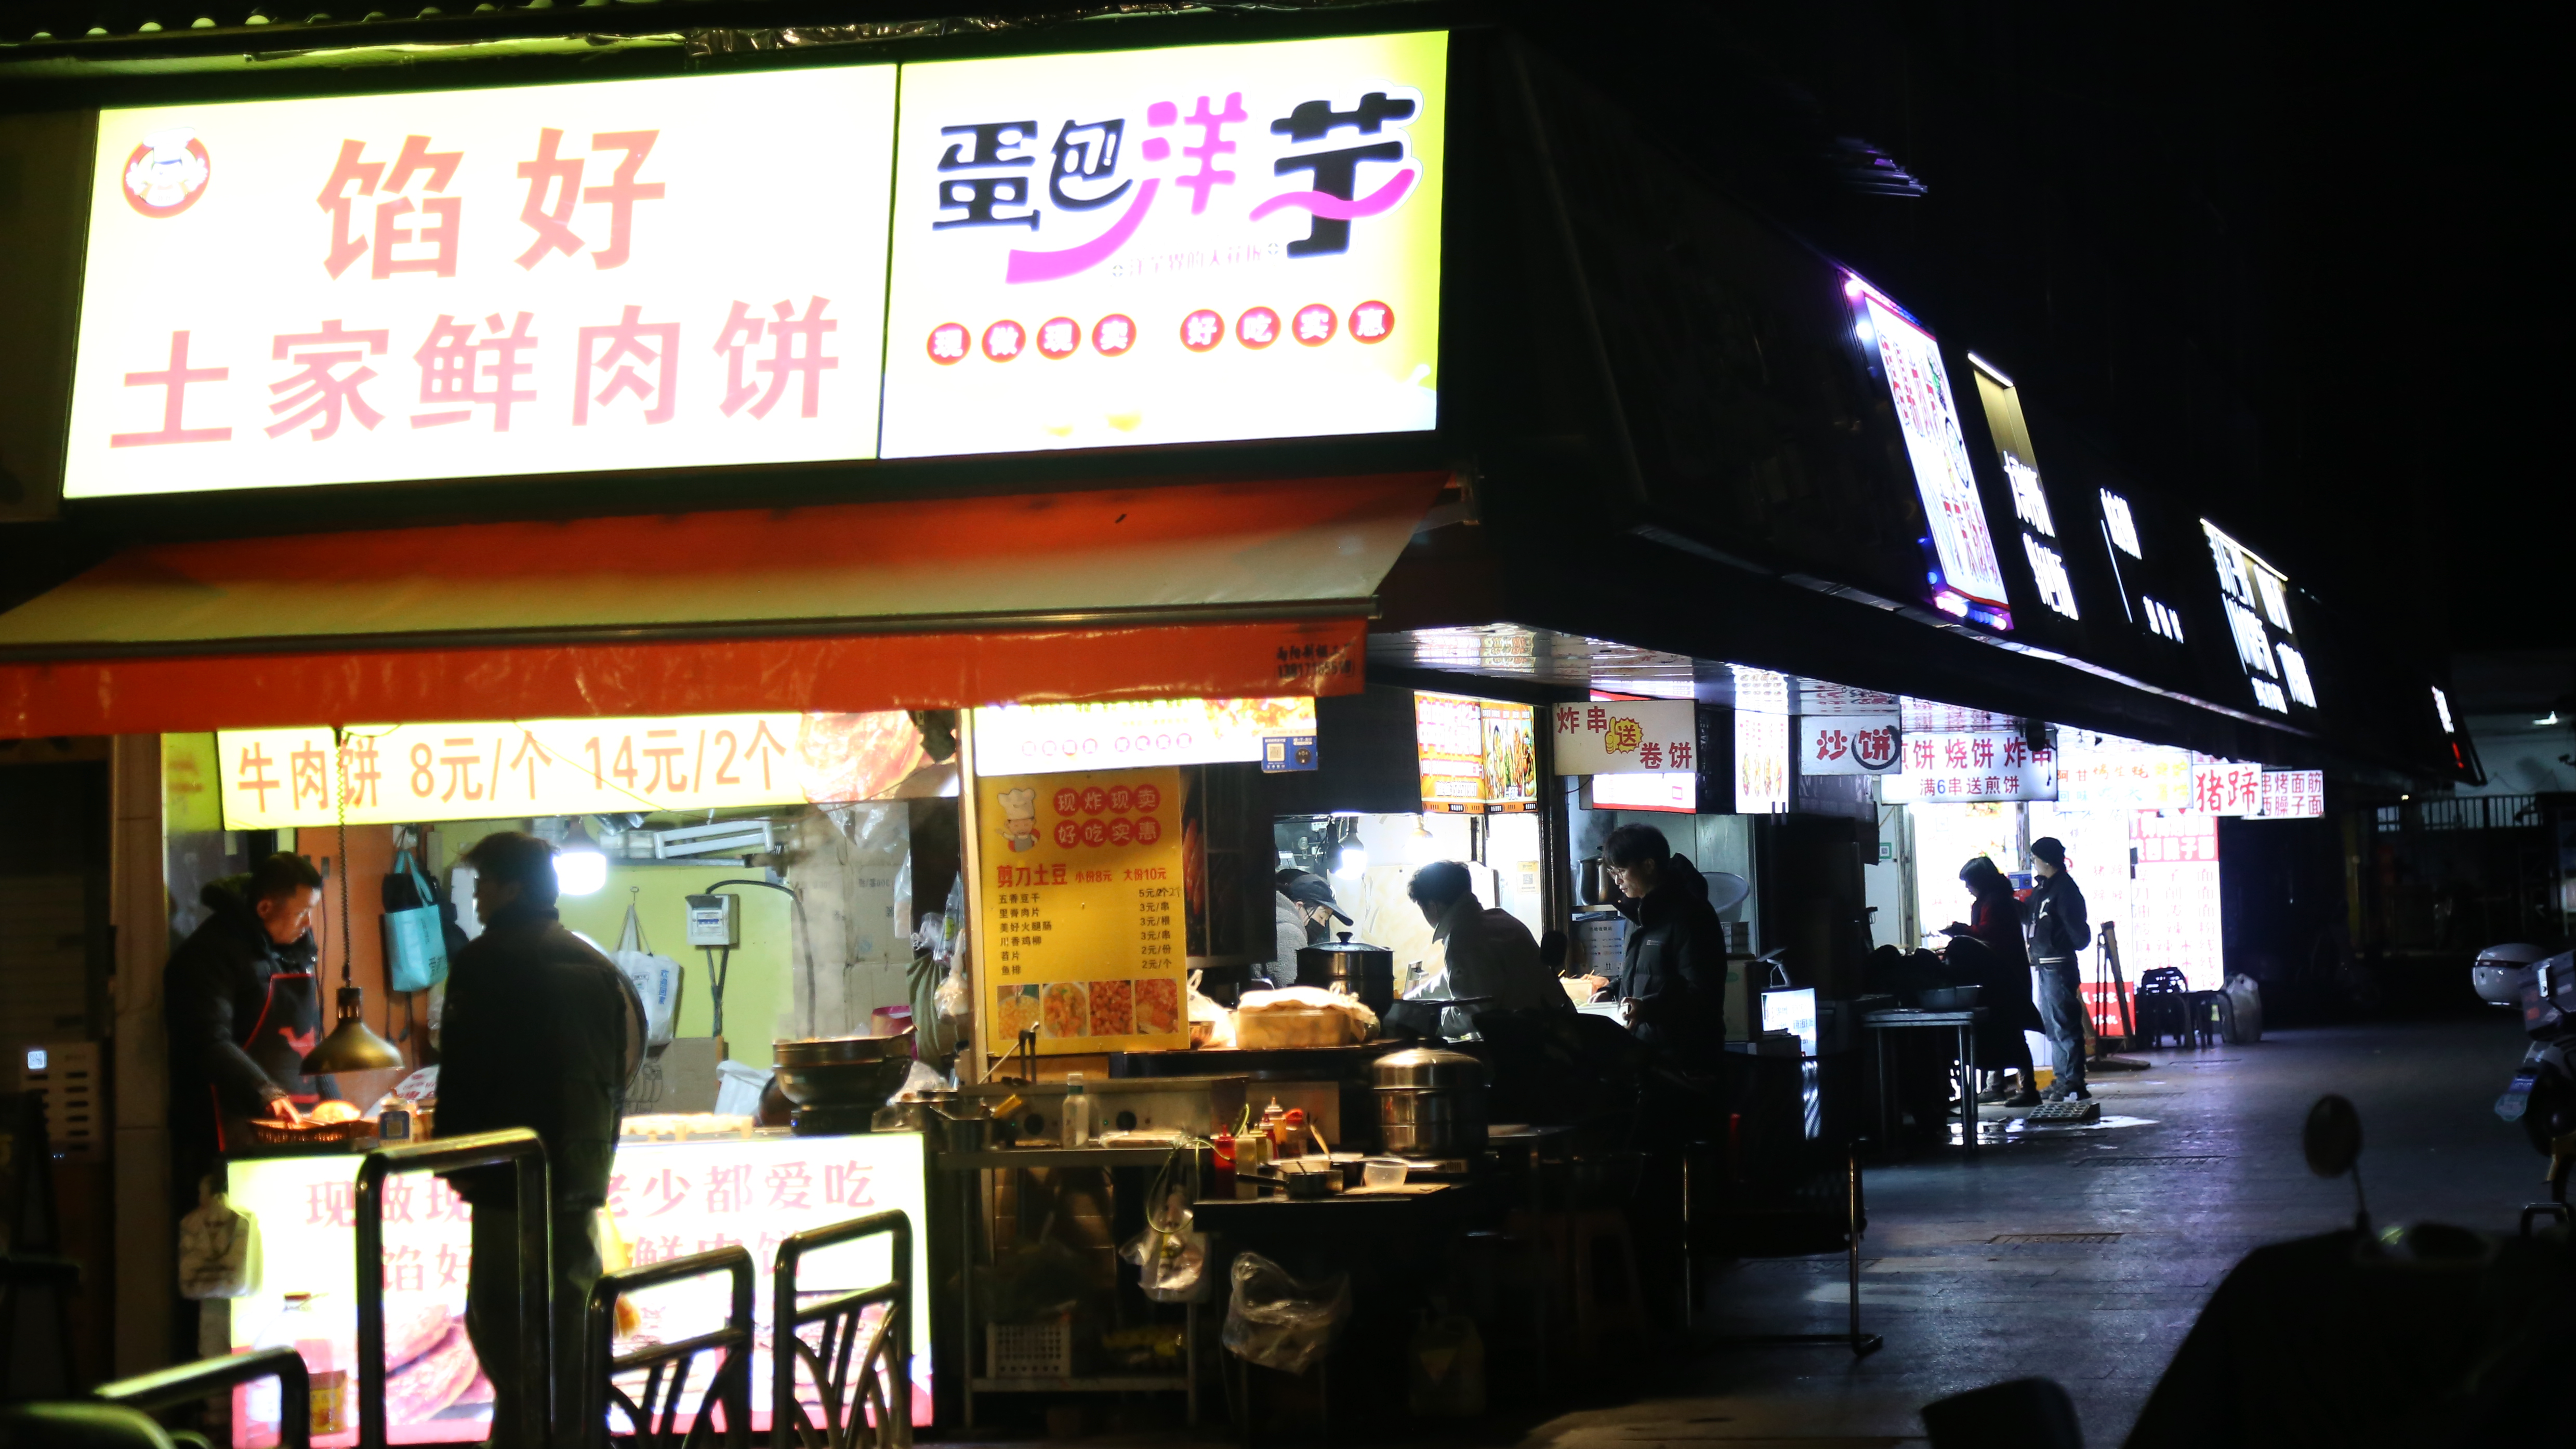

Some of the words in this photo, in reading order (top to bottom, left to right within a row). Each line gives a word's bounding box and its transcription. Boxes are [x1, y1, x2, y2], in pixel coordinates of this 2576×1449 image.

[932, 91, 1416, 284] 蛋包洋芋
[316, 128, 665, 279] 馅好
[934, 319, 1129, 358] 现做现卖
[1187, 308, 1385, 346] 好吃实惠
[110, 295, 838, 448] 土家鲜肉饼
[1557, 706, 1607, 734] 炸串
[1617, 726, 1638, 747] 送
[1817, 729, 1892, 761] 炒饼
[1640, 742, 1693, 769] 卷饼
[1900, 740, 1935, 769] 饼
[1945, 738, 1995, 769] 烧饼
[2003, 737, 2052, 769] 炸串
[237, 739, 382, 812] 牛肉饼
[410, 739, 553, 802] 8元/个
[584, 720, 786, 797] 14元/2个
[1920, 775, 2020, 796] 满6串送煎饼
[2195, 766, 2258, 813] 猪蹄
[1057, 789, 1156, 813] 现炸现卖
[1057, 821, 1157, 844] 好吃实惠
[997, 863, 1068, 888] 剪刀土豆
[1075, 870, 1113, 884] 小份8元
[1124, 867, 1167, 882] 大份10元
[998, 892, 1040, 904] 五香豆干
[999, 907, 1040, 918] 里脊肉片
[1140, 902, 1170, 912] 3元/串
[1000, 921, 1052, 933] 美好火腿肠
[1140, 916, 1170, 927] 3元/根
[1000, 936, 1042, 947] 川香鸡柳
[1140, 931, 1171, 941] 3元/串
[1141, 944, 1171, 955] 2元/份
[1001, 965, 1022, 976] 鱼排
[1142, 958, 1172, 969] 2元/个
